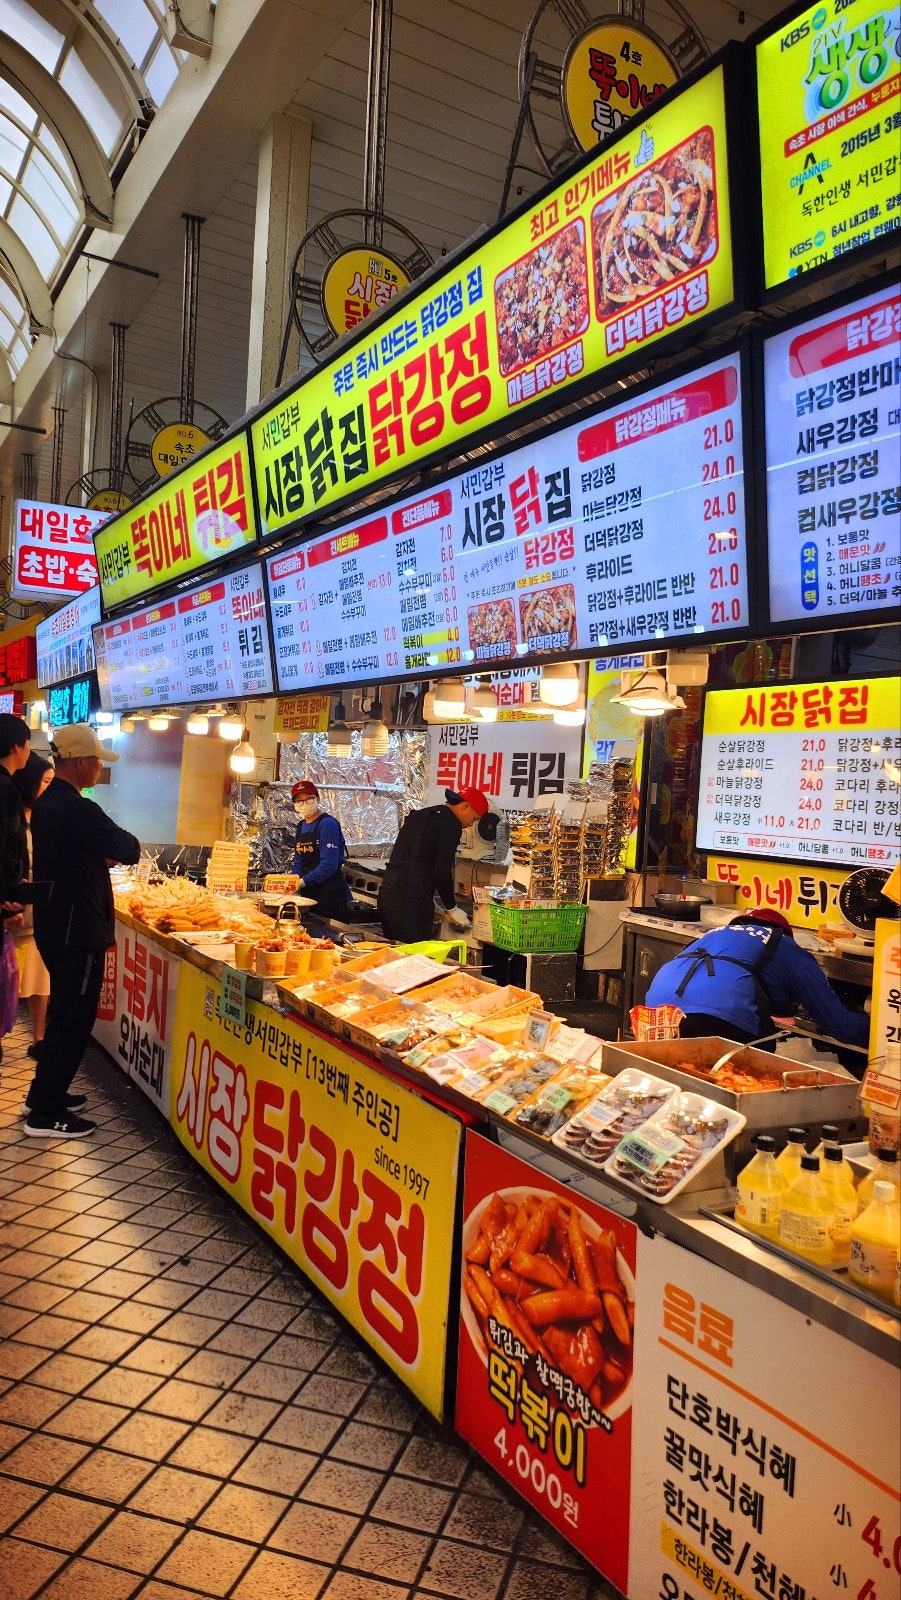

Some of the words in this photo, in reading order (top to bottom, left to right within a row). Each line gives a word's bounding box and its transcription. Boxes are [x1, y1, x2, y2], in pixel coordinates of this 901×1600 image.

[620, 41, 642, 66] 4호
[780, 20, 810, 52] KBS
[592, 100, 632, 146] 튀
[789, 133, 805, 151] 속초
[808, 123, 825, 140] 시장
[840, 124, 881, 159] 2015년
[789, 158, 832, 189] CHANNEL
[529, 199, 560, 244] 최고
[565, 150, 631, 217] 인기메뉴
[801, 178, 851, 217] 독한인생
[831, 220, 847, 237] 6시
[789, 240, 813, 258] KBS
[804, 251, 828, 271] YTN
[332, 364, 355, 398] 주문
[356, 343, 380, 376] 즉시
[380, 320, 418, 366] 만드는
[420, 279, 463, 338] 닭강정
[466, 266, 483, 307] 집
[605, 271, 709, 358] 더덕닭강정
[507, 341, 584, 407] 마늘닭강정
[262, 401, 302, 451] 서민갑부
[615, 395, 687, 443] 닭강정메뉴
[797, 407, 878, 456] 새우강정
[174, 443, 195, 455] 속초
[580, 463, 616, 494] 닭강정
[703, 418, 734, 451] 21.0
[460, 462, 505, 500] 서민갑부
[582, 486, 643, 523] 마늘닭강정
[702, 456, 735, 487] 24.0
[797, 450, 879, 495] 컵닭강정
[101, 541, 131, 581] 서민갑부
[130, 488, 191, 579] 똑이네
[192, 449, 249, 534] 튀김
[584, 519, 644, 553] 더덕닭강정
[703, 492, 736, 522] 24.0
[798, 486, 901, 534] 컵새우강정
[395, 538, 416, 557] 감자전
[440, 524, 452, 541] 7.0
[441, 545, 454, 563] 6.0
[523, 526, 575, 571] 닭강정
[586, 554, 633, 583] 후라이드
[708, 527, 738, 555] 21.0
[826, 552, 836, 562] 2.
[838, 544, 871, 561] 매운맛
[837, 529, 869, 546] 보통맛
[399, 572, 433, 594] 수수부꾸미
[442, 566, 456, 583] 6.0
[709, 563, 740, 590] 21.0
[827, 566, 836, 577] 3.
[839, 557, 881, 575] 허니달콤
[827, 581, 837, 591] 4.
[840, 572, 882, 589] 허니땡초
[232, 588, 264, 623] 똑이네
[443, 586, 457, 603] 6.0
[587, 577, 668, 613] 닭강정+후라이드
[671, 572, 695, 594] 반반
[827, 595, 837, 606] 5.
[839, 587, 888, 605] 더덕/마늘
[445, 607, 458, 623] 6.0
[589, 608, 669, 646] 닭강정+새우강정
[673, 605, 697, 628] 반반
[710, 598, 741, 624] 21.0
[238, 625, 263, 657] 튀김
[403, 634, 423, 651] 떡볶이
[447, 628, 459, 643] 4.0
[446, 648, 461, 664] 12.0
[740, 685, 869, 728] 시장닭집
[438, 725, 479, 747] 서민갑부
[718, 740, 765, 753] 순살닭강정
[802, 739, 826, 752] 21.0
[437, 752, 503, 797] 똑이네
[510, 752, 566, 799] 튀김
[717, 758, 774, 771] 순살후라이드
[801, 759, 825, 772] 21.0
[716, 776, 763, 790] 마늘닭강정
[800, 778, 823, 792] 24.0
[834, 779, 869, 793] 코다리
[715, 794, 761, 808] 더덕닭강정
[798, 798, 822, 811] 24.0
[833, 799, 868, 815] 코다리
[874, 800, 899, 816] 강정
[714, 811, 751, 827] 새우강정
[763, 815, 785, 828] 11.0
[797, 817, 821, 830] 21.0
[832, 819, 867, 834] 코다리
[374, 1145, 400, 1181] since
[403, 1164, 430, 1201] 1997
[177, 1031, 251, 1184] 시장
[250, 1079, 426, 1367] 닭강정
[663, 1281, 734, 1369] 음료
[488, 1320, 529, 1370] 튀김과
[487, 1351, 586, 1488] 떡볶이
[667, 1374, 797, 1500] 단호박식혜
[493, 1427, 579, 1532] 4,000원
[664, 1427, 764, 1536] 꿀맛식혜
